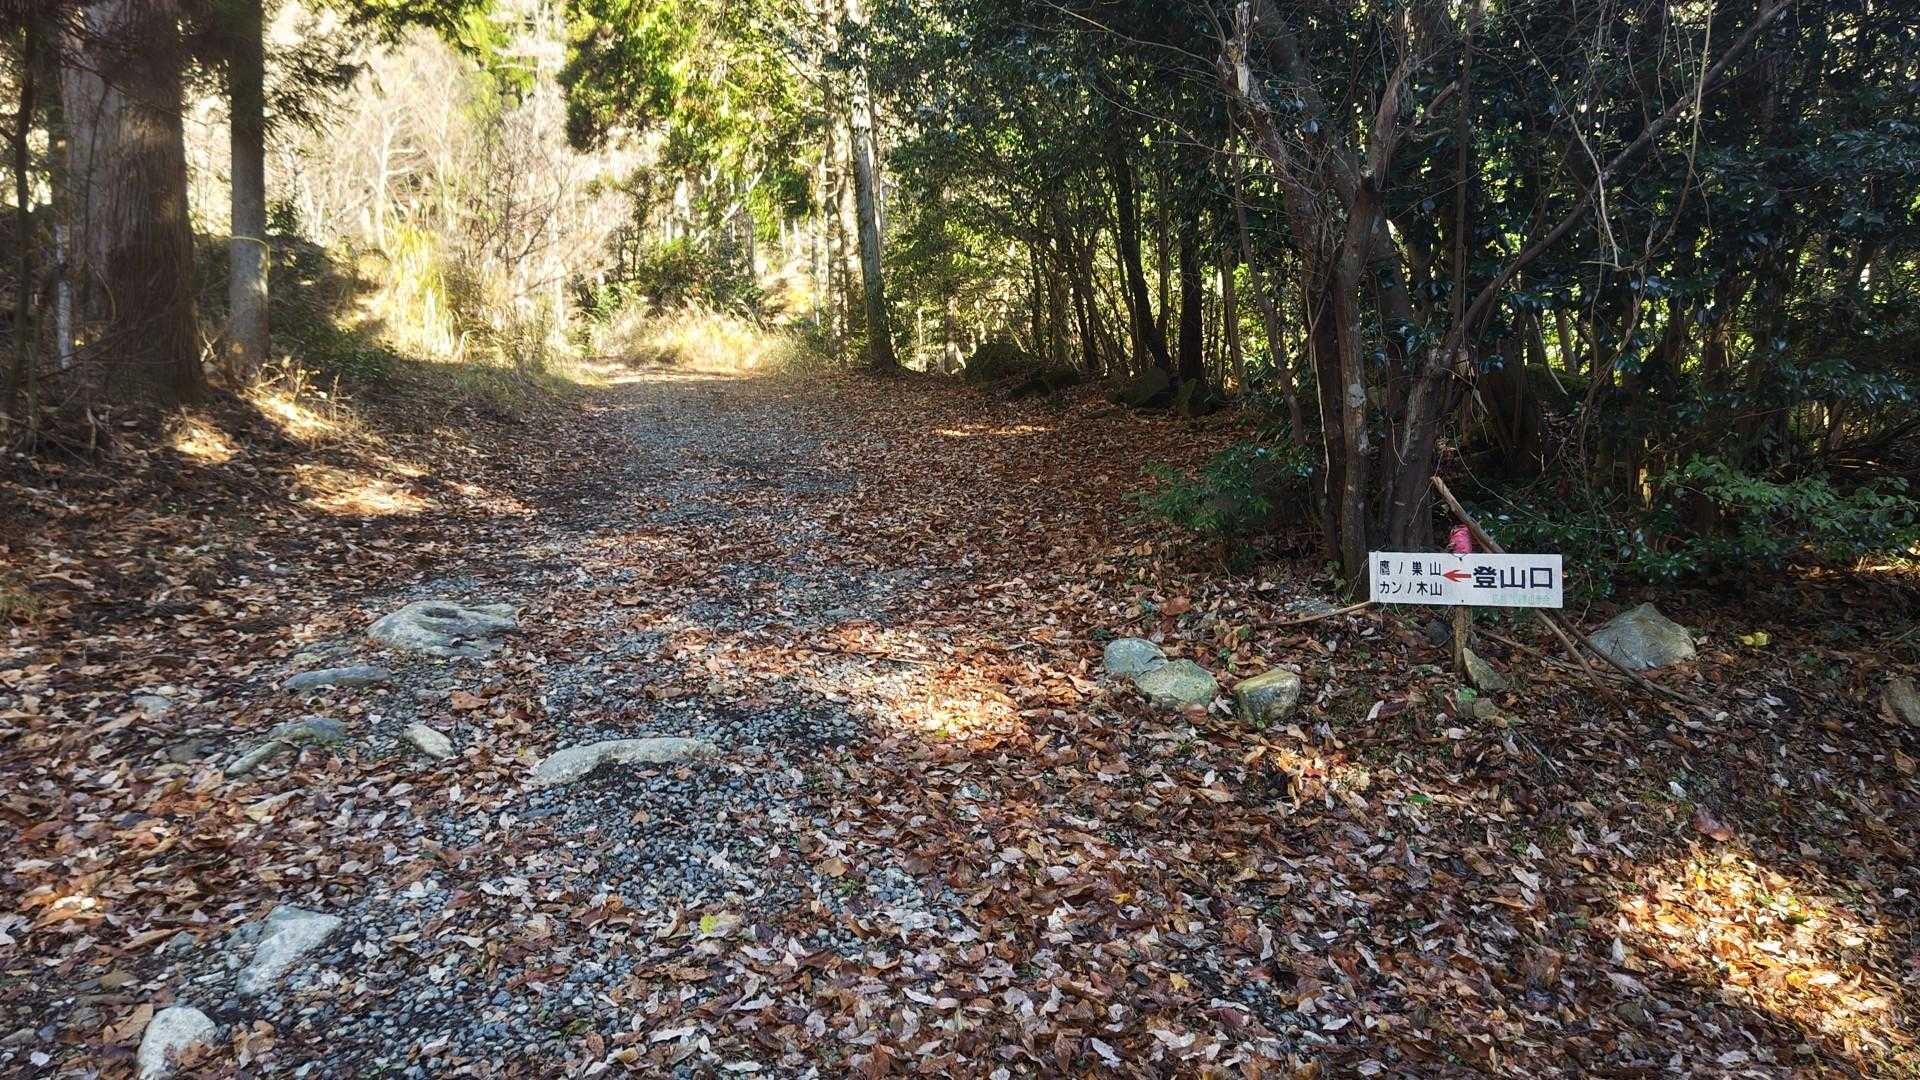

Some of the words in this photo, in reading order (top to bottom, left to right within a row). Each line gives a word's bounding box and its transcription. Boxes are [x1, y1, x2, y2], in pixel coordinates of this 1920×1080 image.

[1473, 565, 1553, 590] 登山口
[1379, 581, 1443, 596] カンノ木山
